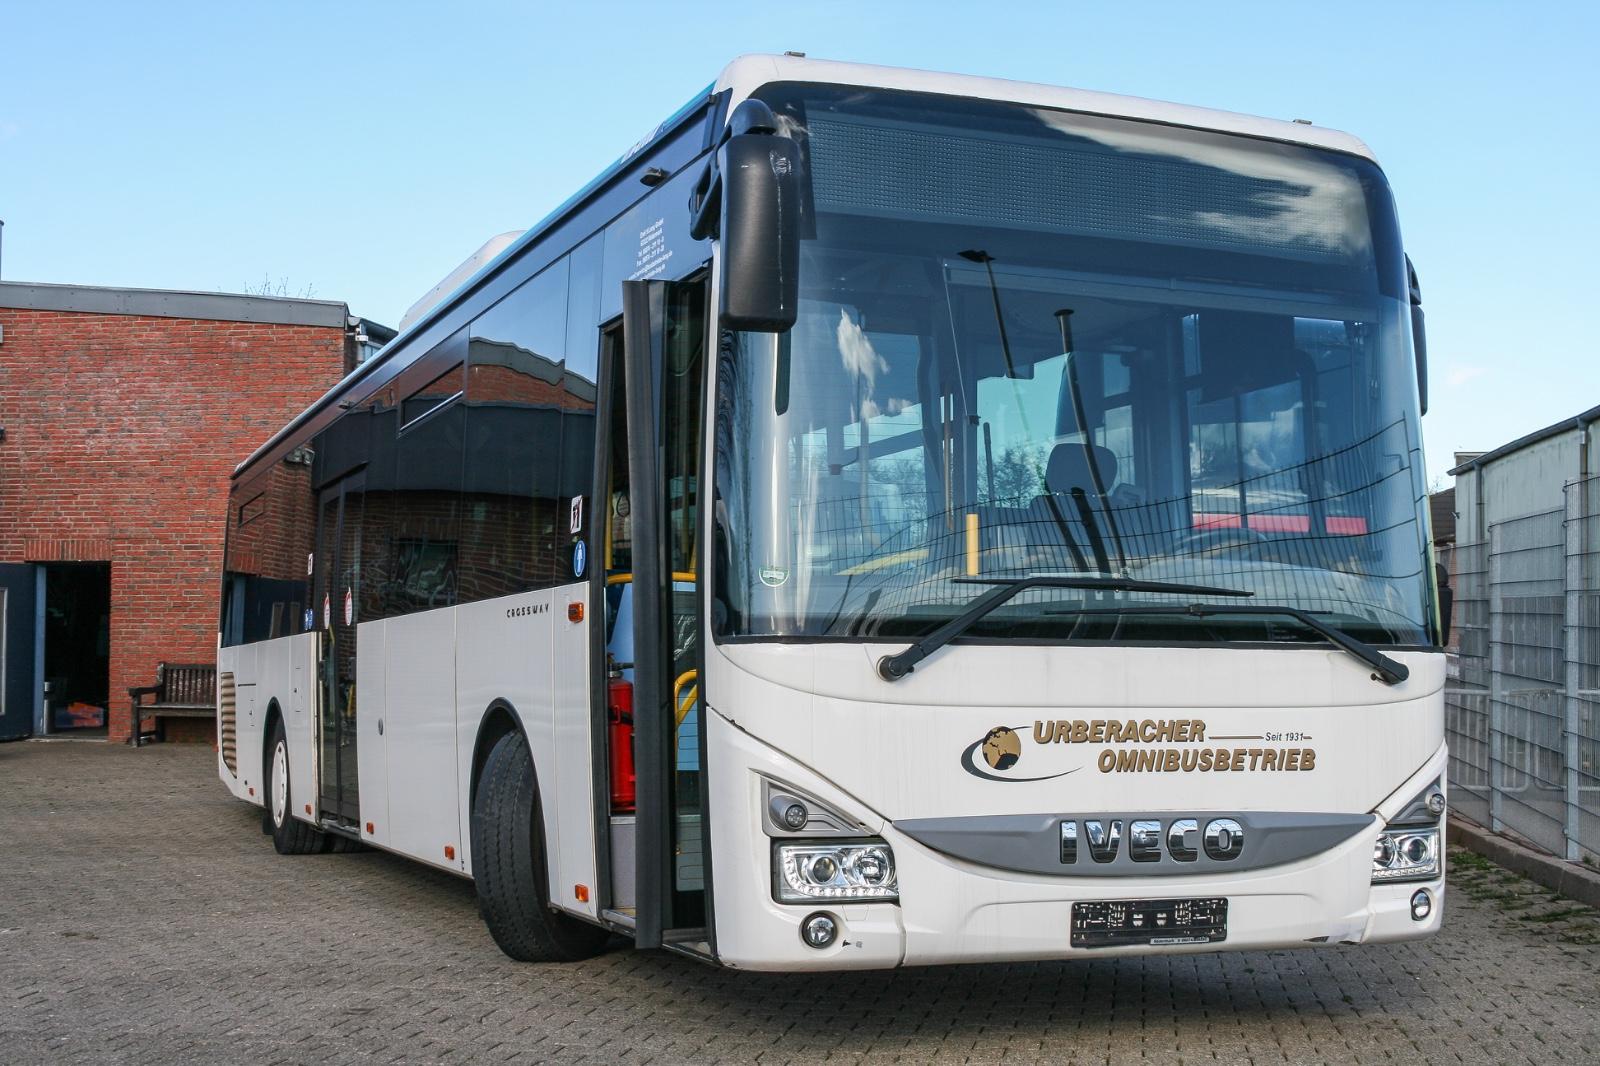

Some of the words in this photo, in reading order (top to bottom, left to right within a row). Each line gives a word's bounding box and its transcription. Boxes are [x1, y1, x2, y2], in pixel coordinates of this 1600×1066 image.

[506, 603, 549, 618] CROSSWAY
[1033, 719, 1206, 744] URBERACHER
[1265, 732, 1281, 742] Seit
[1285, 732, 1304, 742] 1931
[1097, 748, 1316, 773] OMNIBUSBETRIEB
[1058, 817, 1245, 864] IVECO
